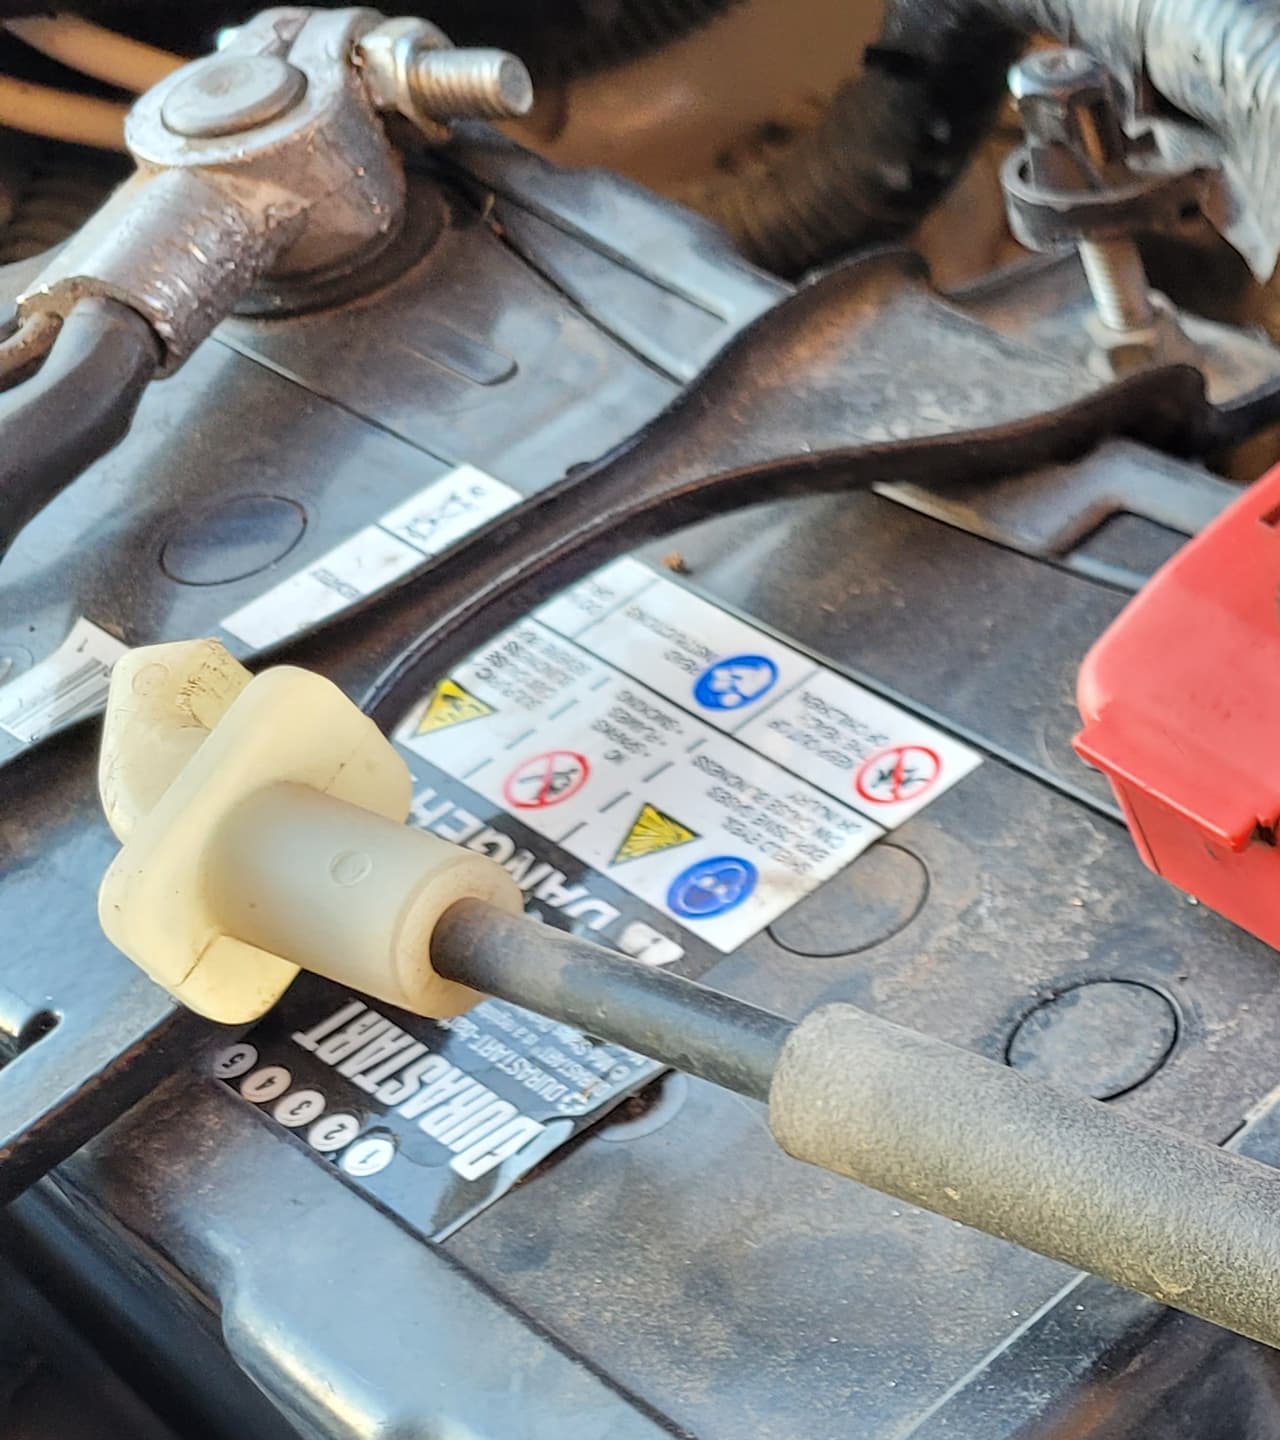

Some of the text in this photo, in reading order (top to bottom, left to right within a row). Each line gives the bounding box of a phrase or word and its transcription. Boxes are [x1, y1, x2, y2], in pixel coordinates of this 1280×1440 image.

[403, 786, 623, 930] DANGER
[220, 1049, 376, 1167] 1 2 3 4 5
[289, 997, 545, 1183] DURASTART
